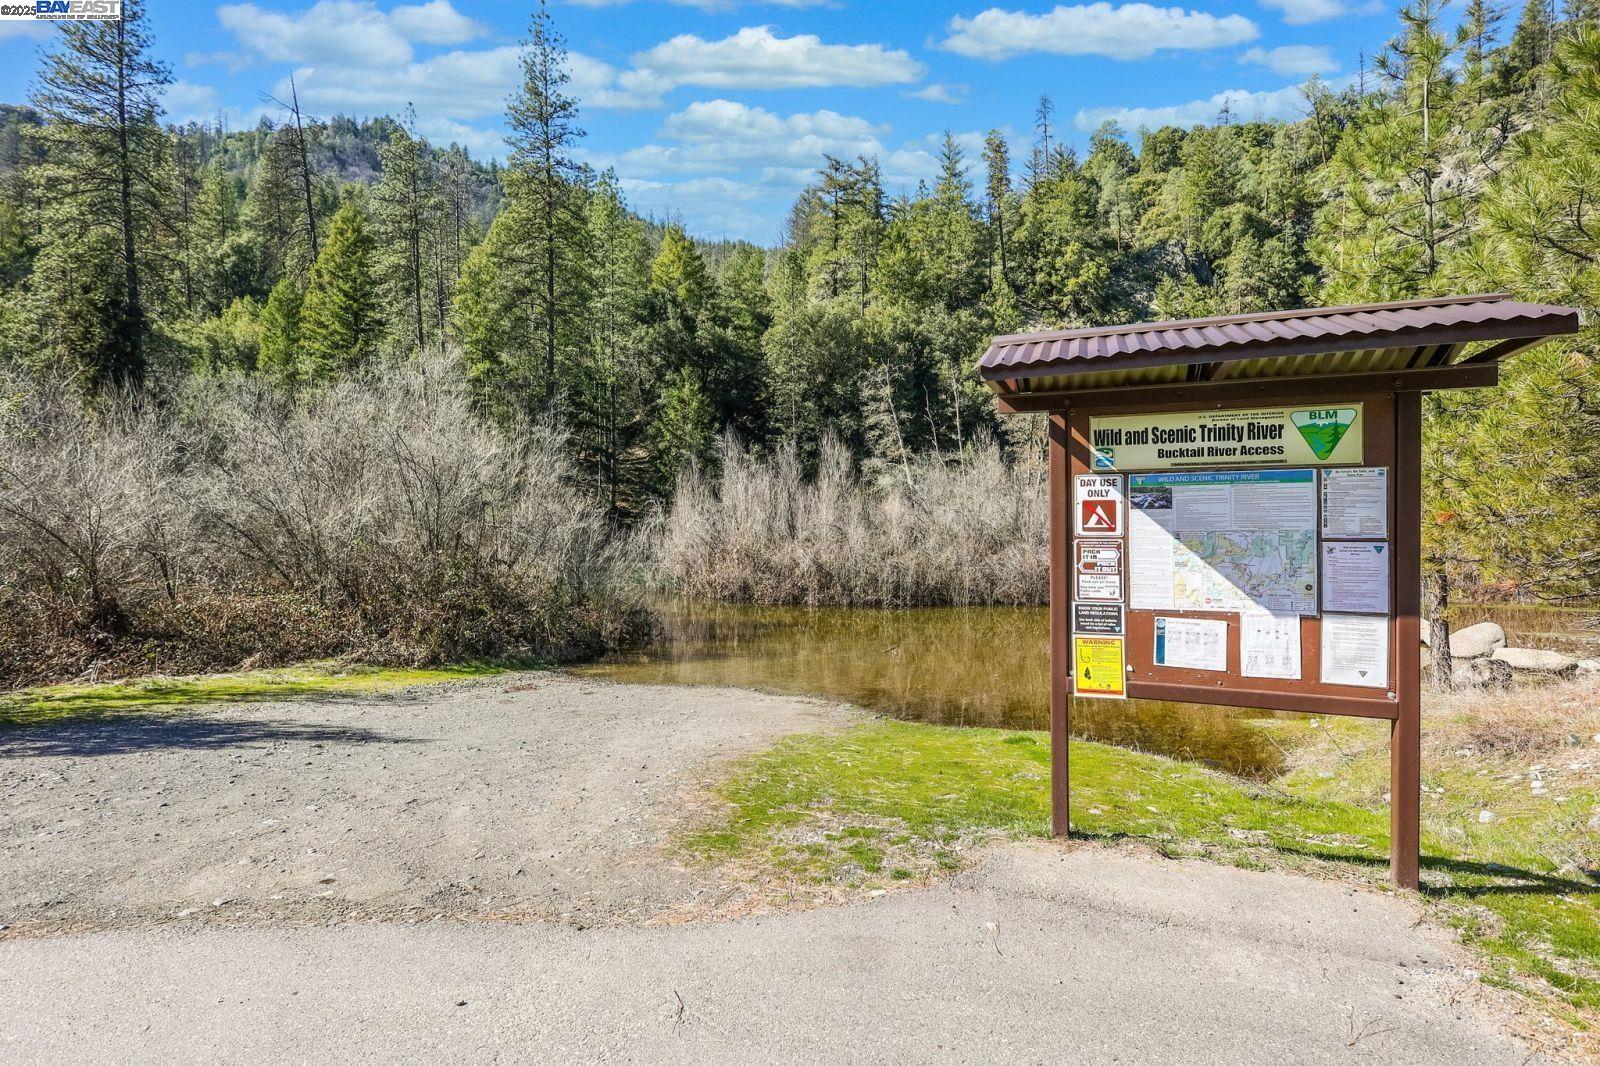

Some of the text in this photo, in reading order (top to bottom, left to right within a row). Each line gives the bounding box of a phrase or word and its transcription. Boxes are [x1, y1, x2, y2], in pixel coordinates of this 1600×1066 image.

[1309, 411, 1338, 420] BLM
[1094, 422, 1284, 446] Wild and Scenic Trinity River
[1157, 445, 1284, 459] Bucktail River Access
[1080, 478, 1118, 487] DAY USE
[1087, 489, 1110, 497] ONLY
